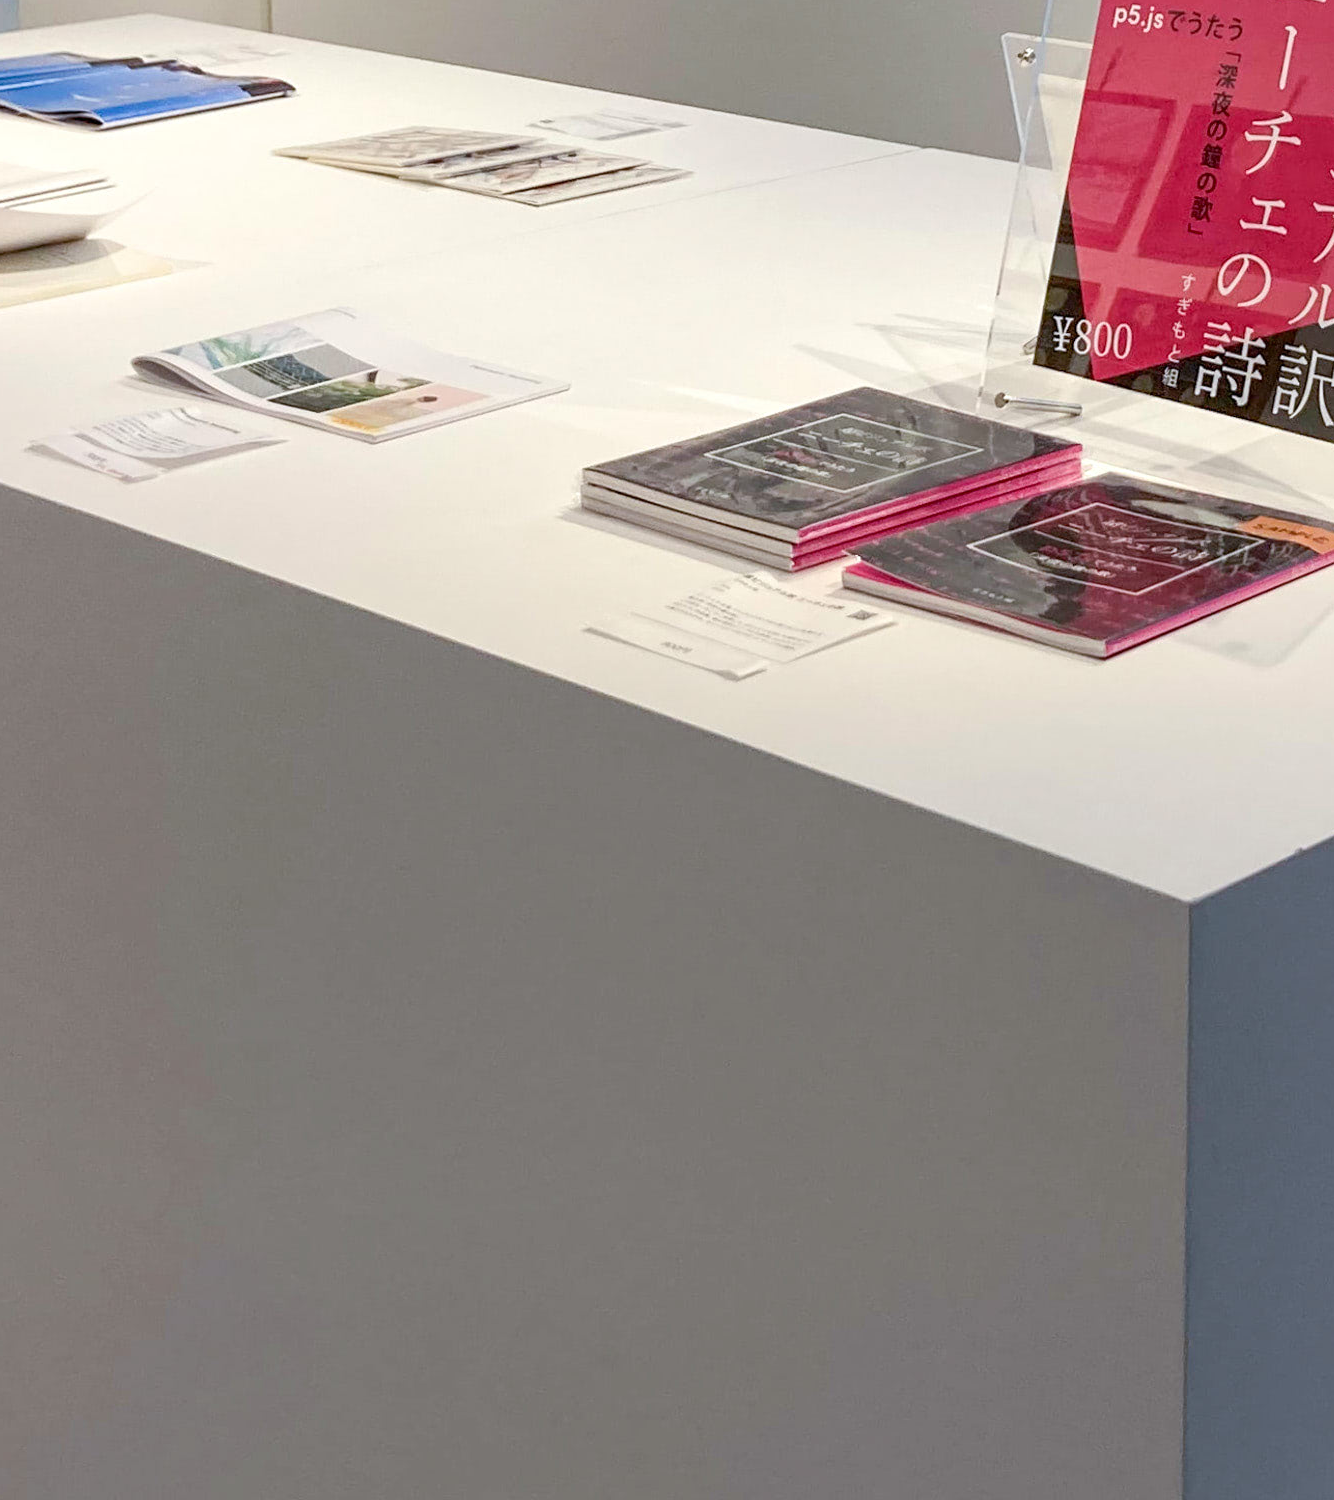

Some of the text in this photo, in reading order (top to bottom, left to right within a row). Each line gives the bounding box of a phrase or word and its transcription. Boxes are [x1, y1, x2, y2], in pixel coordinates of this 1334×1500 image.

[1052, 315, 1133, 360] ¥800
[1162, 273, 1196, 389] すぎもと組
